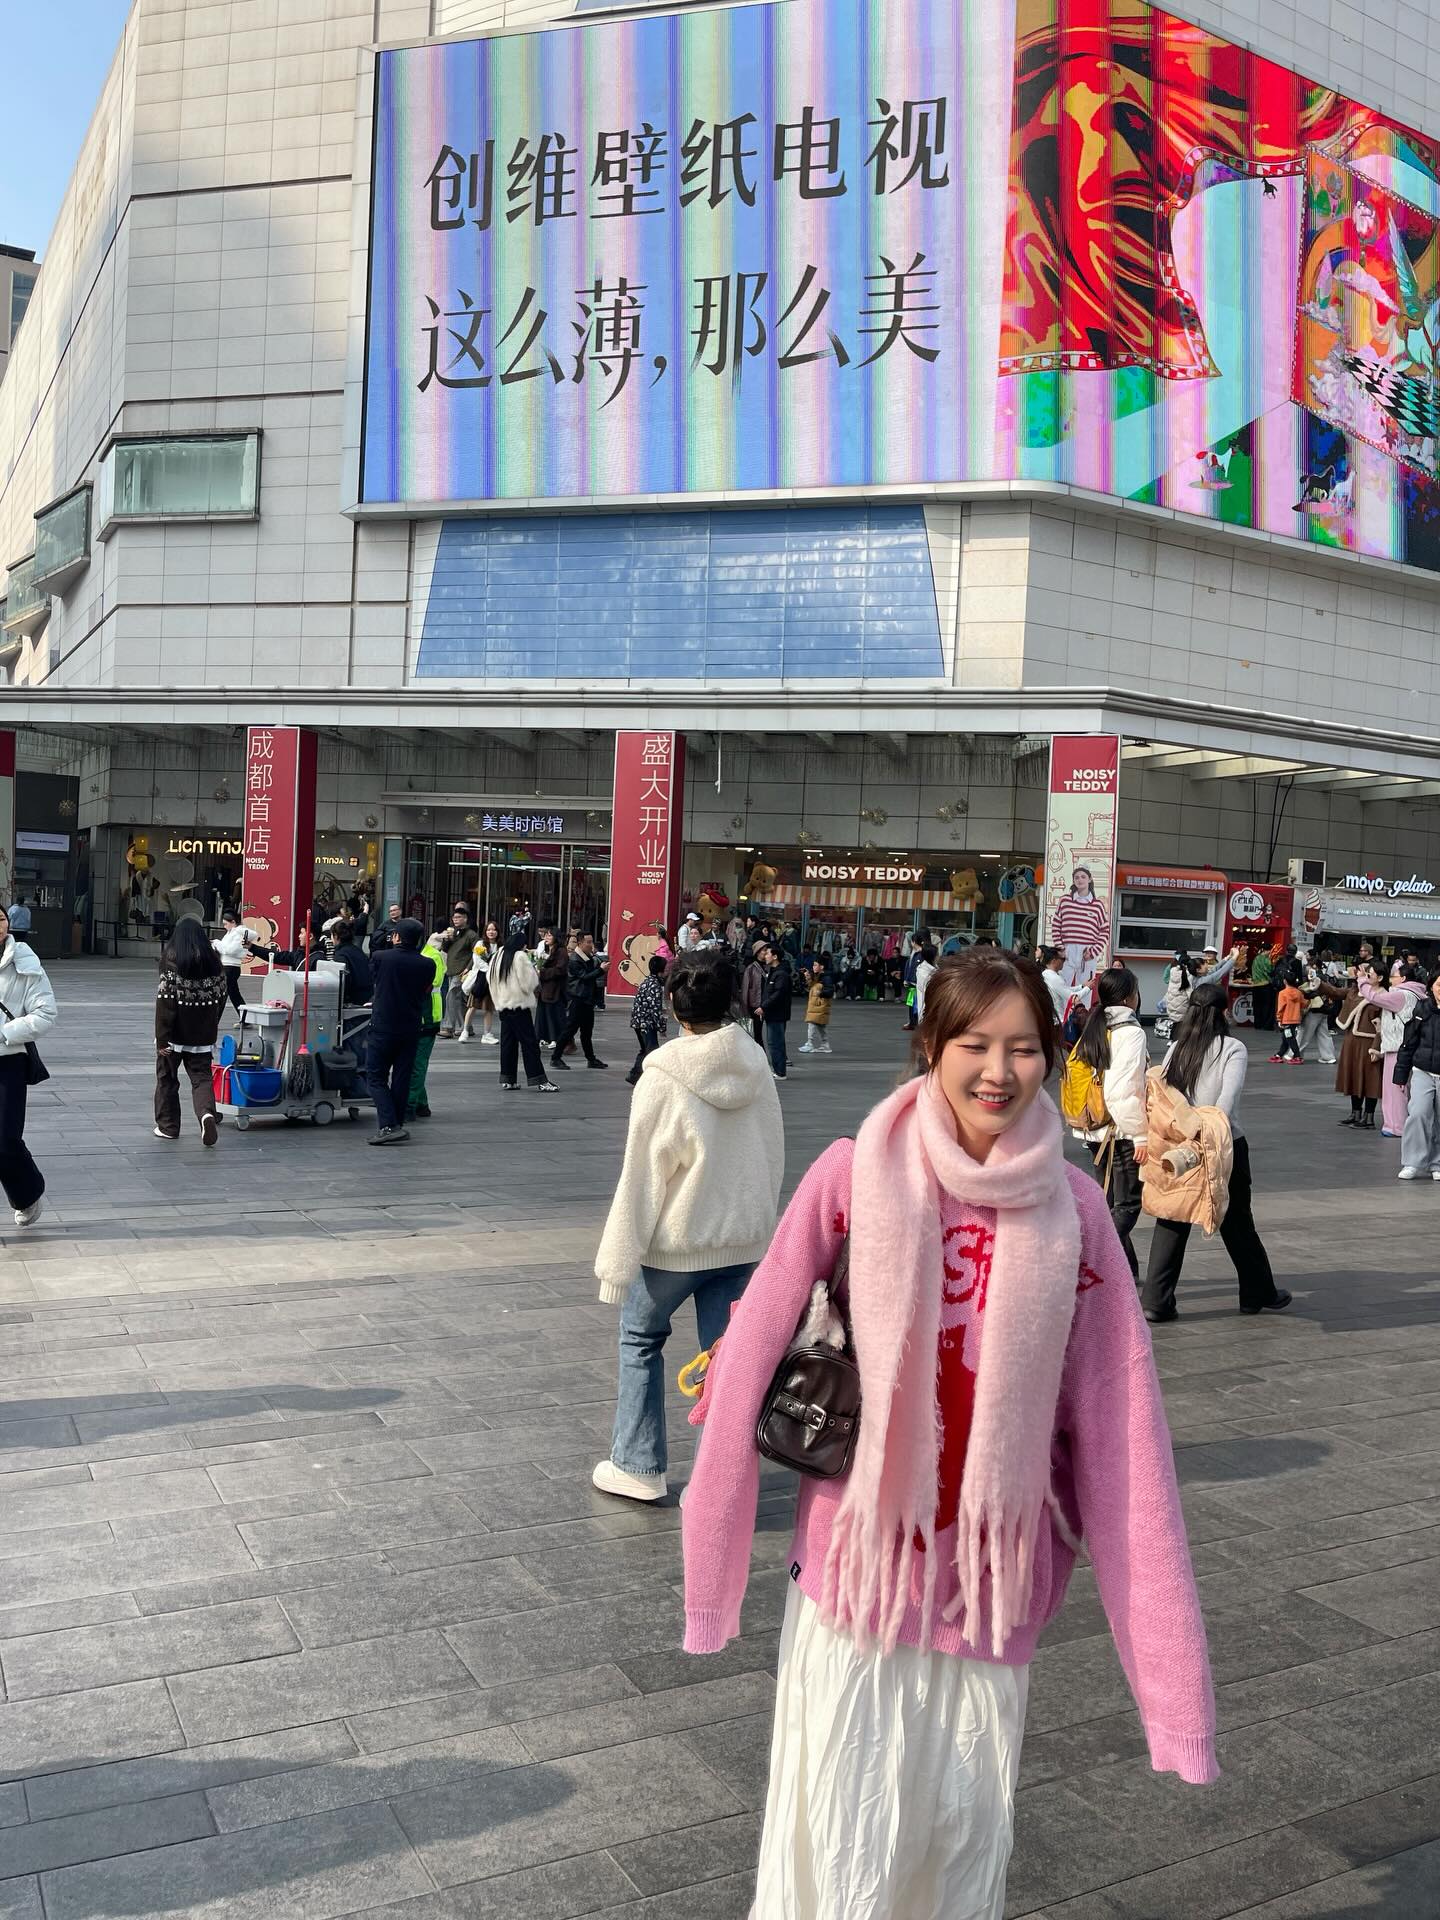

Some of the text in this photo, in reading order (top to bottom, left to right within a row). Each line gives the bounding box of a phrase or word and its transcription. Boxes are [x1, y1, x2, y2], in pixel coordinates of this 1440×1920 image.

[423, 96, 950, 232] 创维壁纸电视
[1072, 769, 1116, 780] NOISY
[246, 731, 274, 854] 成都首店
[1063, 780, 1110, 791] TEDDY
[636, 735, 671, 868] 盛大开业
[482, 814, 564, 833] 美美时尚馆
[636, 877, 662, 885] TEDDY
[805, 865, 923, 882] NOISY TEDDY
[1387, 874, 1436, 898] gelato
